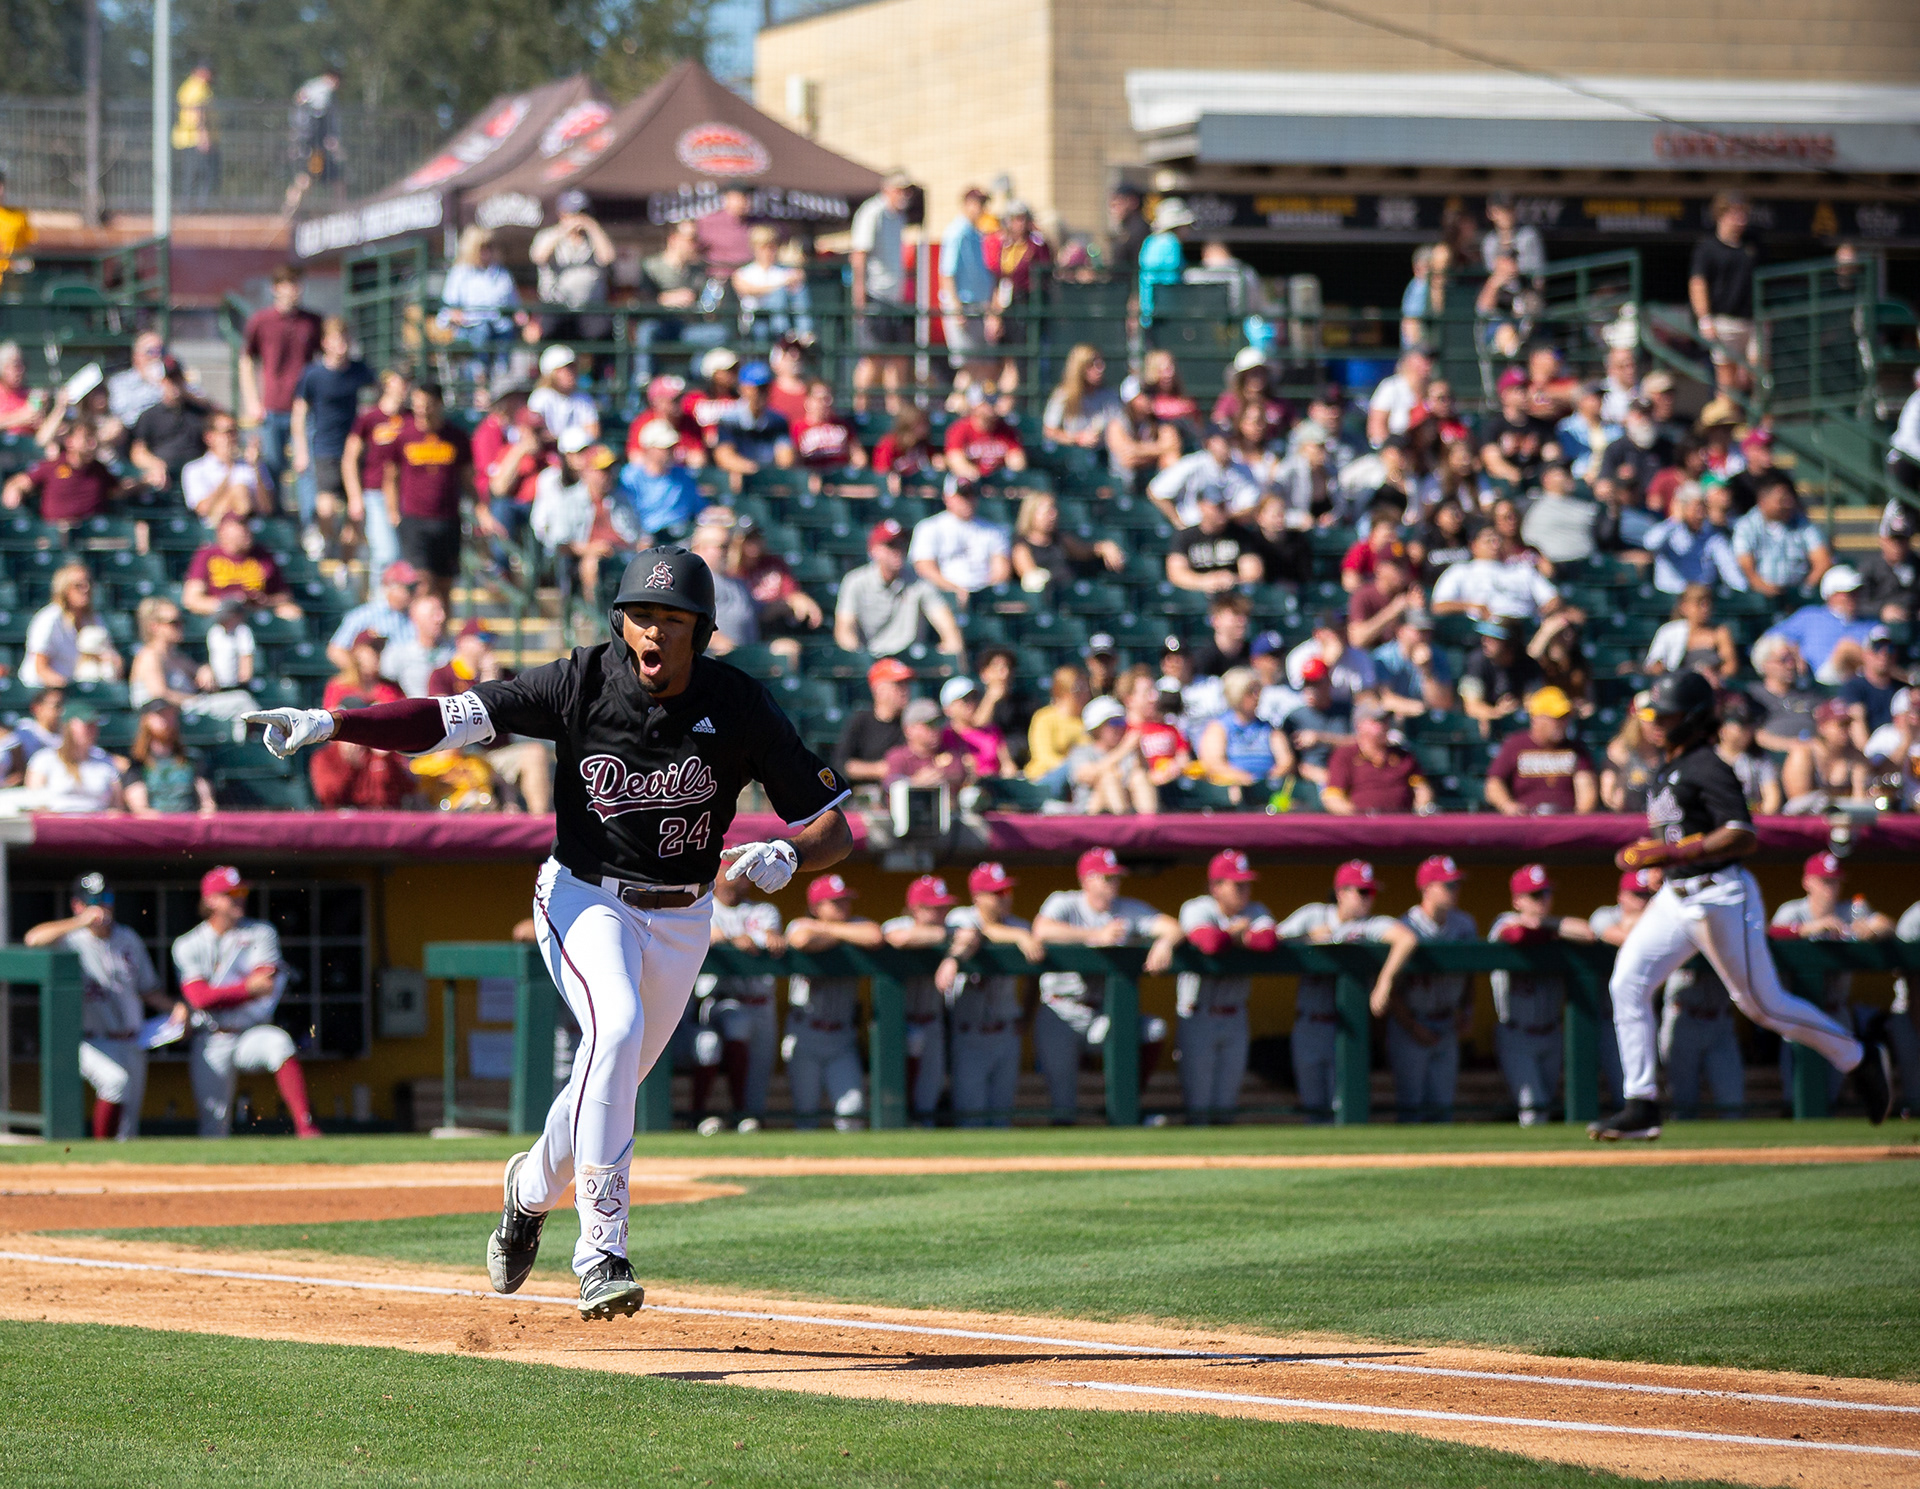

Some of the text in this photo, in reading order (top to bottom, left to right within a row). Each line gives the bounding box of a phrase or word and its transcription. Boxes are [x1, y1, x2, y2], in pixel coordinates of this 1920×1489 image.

[692, 725, 716, 734] adidas
[580, 754, 717, 802] Devils
[658, 811, 711, 858] 24
